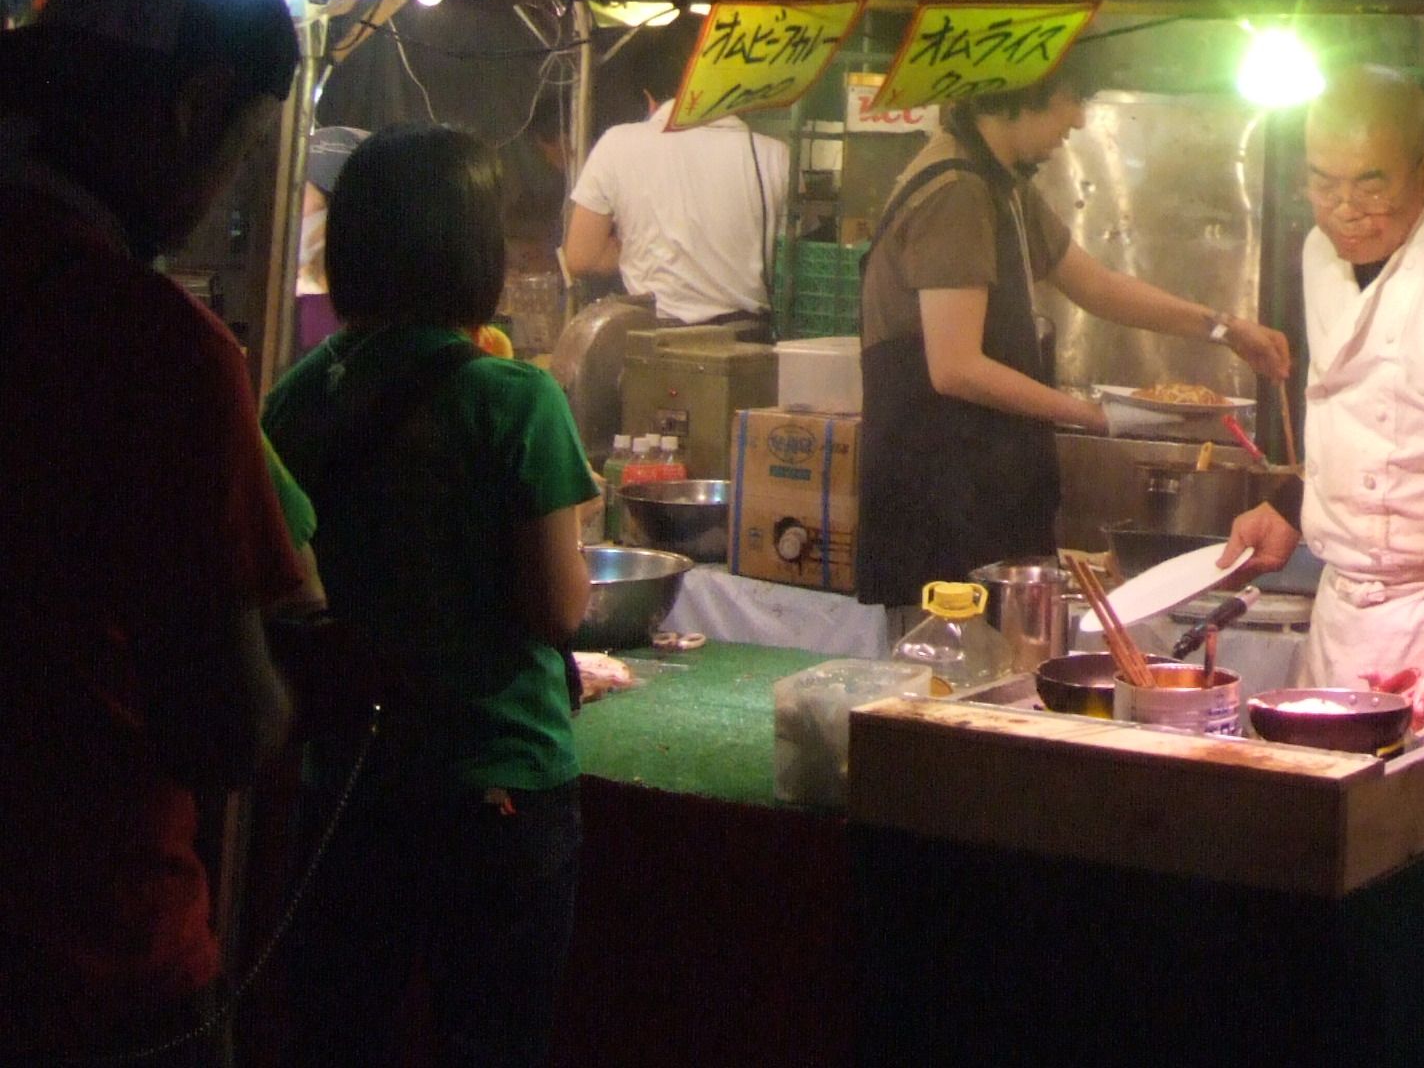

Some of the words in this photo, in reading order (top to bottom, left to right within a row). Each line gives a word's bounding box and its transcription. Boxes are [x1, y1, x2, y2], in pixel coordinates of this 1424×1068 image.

[908, 15, 1067, 68] オムライス
